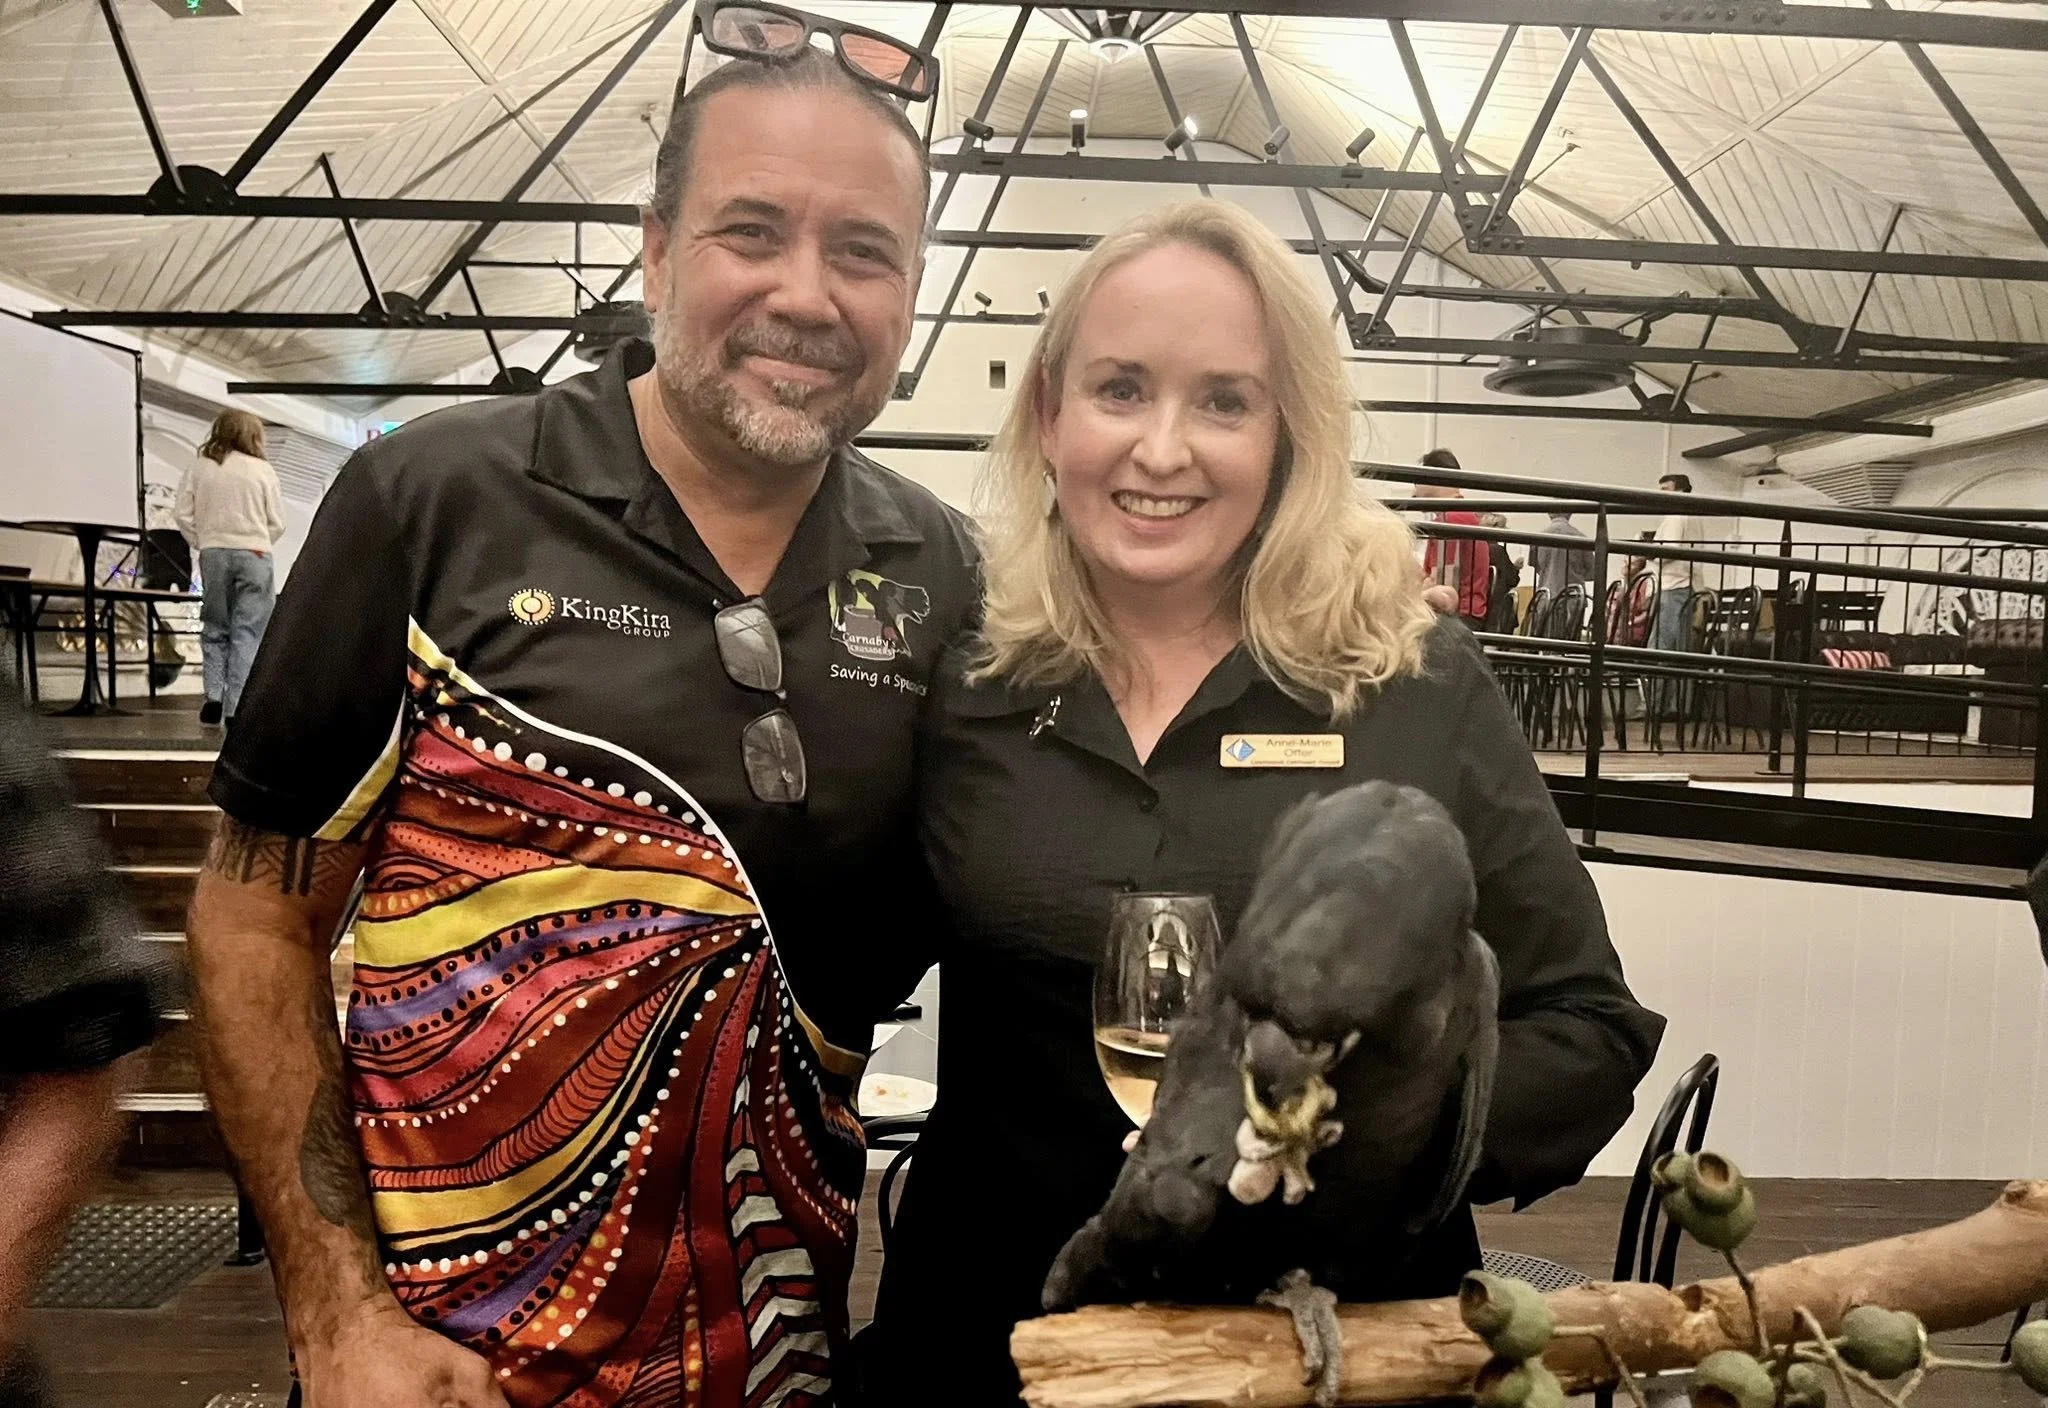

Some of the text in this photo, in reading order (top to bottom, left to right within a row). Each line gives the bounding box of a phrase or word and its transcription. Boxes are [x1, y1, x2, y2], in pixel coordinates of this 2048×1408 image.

[560, 597, 671, 630] KingKira
[623, 626, 670, 638] GROUP
[830, 664, 878, 687] Saving
[883, 674, 890, 685] a
